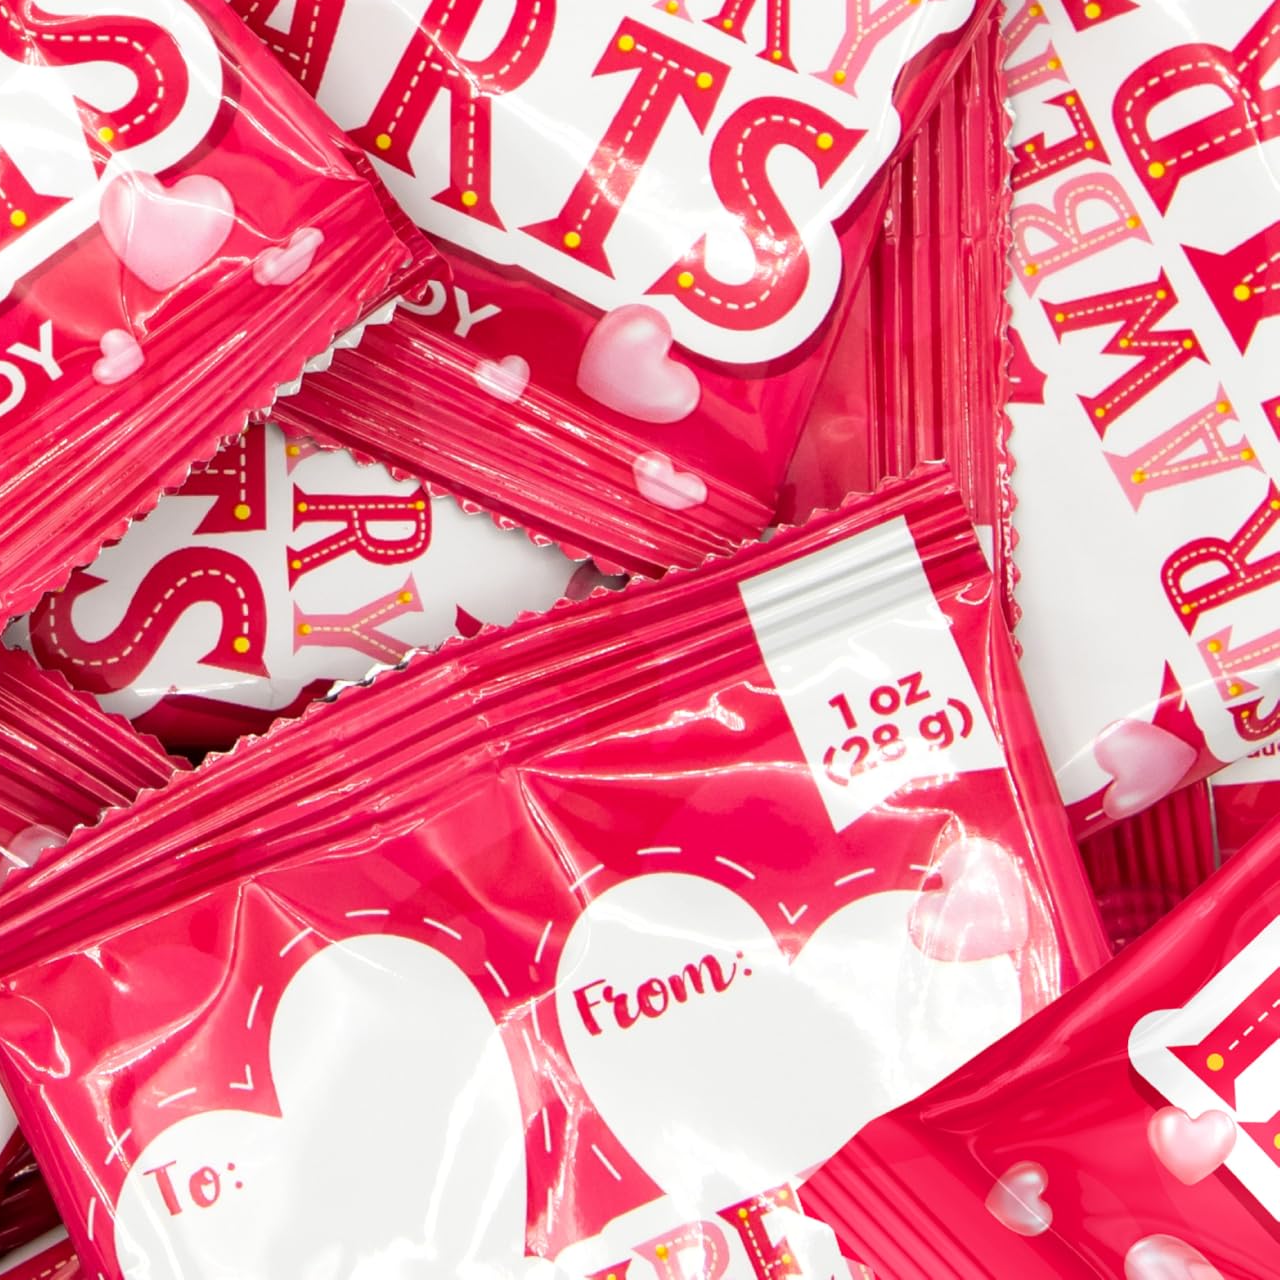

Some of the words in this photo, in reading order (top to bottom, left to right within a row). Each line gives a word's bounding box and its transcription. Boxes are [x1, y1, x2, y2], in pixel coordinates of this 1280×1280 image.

[828, 693, 857, 730] 1
[869, 670, 931, 717] oz
[822, 721, 910, 789] (28
[919, 697, 973, 751] g)
[572, 950, 753, 1036] From:
[143, 1160, 244, 1217] To:
